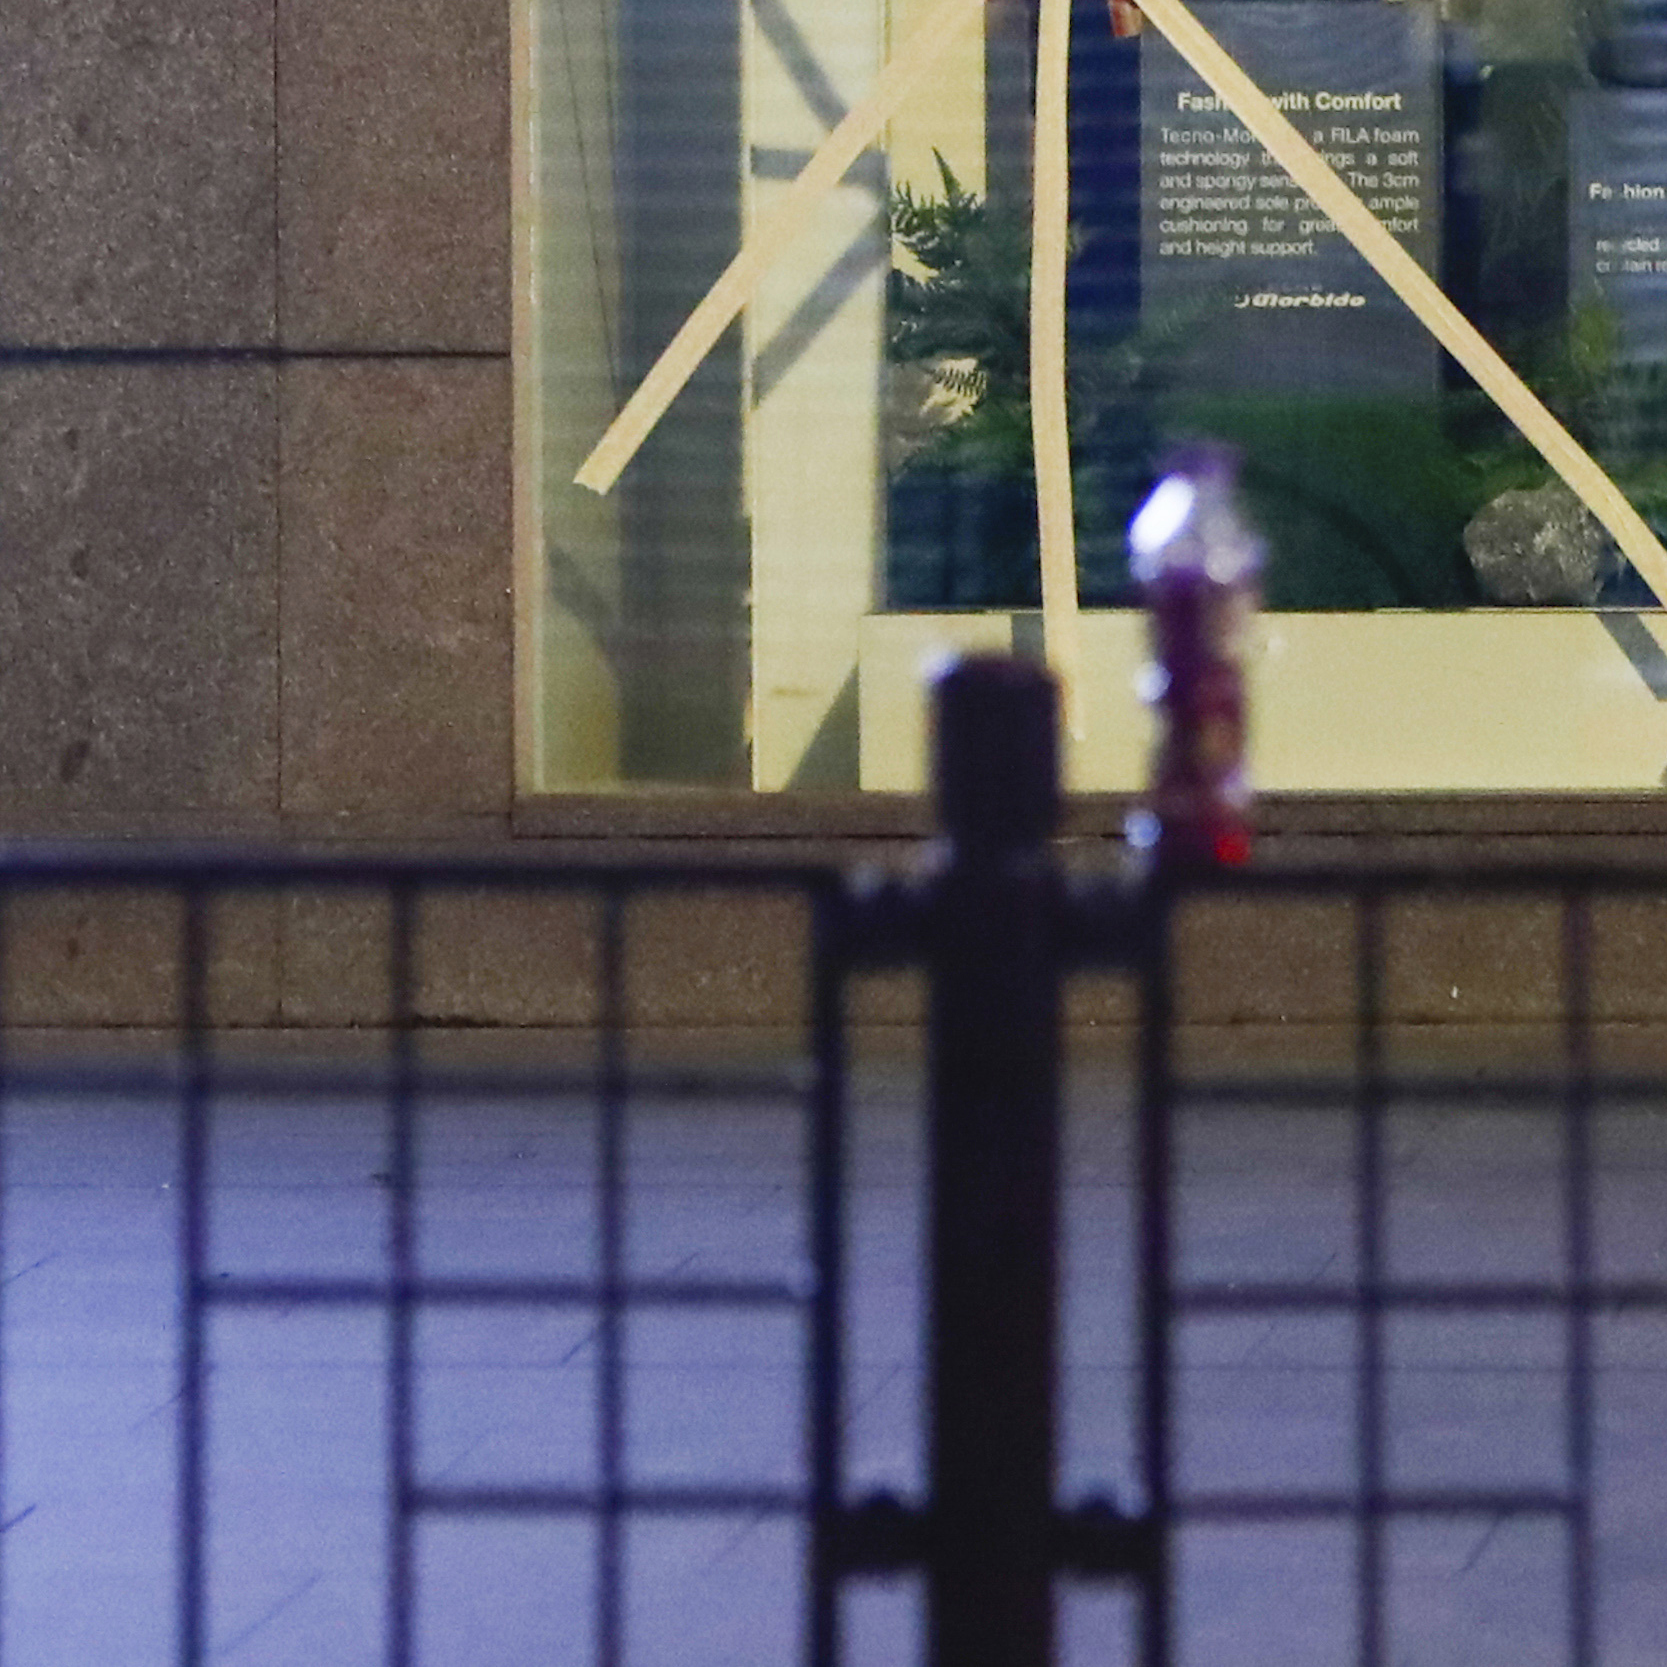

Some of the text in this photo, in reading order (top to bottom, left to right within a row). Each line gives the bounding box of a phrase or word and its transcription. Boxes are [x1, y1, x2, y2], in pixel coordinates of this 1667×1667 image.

[1177, 93, 1230, 111] Fash
[1315, 92, 1402, 111] Comfort
[1313, 130, 1323, 144] a
[1330, 128, 1369, 144] FILA
[1373, 128, 1420, 144] foam
[1159, 151, 1250, 169] technology
[1365, 154, 1377, 166] a
[1388, 151, 1419, 166] soft
[1159, 173, 1192, 189] and
[1195, 174, 1255, 192] spongy
[1349, 172, 1379, 188] The
[1382, 172, 1420, 188] 3cm
[1159, 195, 1252, 214] engineered
[1255, 195, 1290, 211] sole
[1368, 196, 1420, 214] ample
[1159, 217, 1248, 236] cushioning
[1262, 217, 1286, 232] for
[1159, 239, 1192, 255] and
[1196, 239, 1248, 259] height
